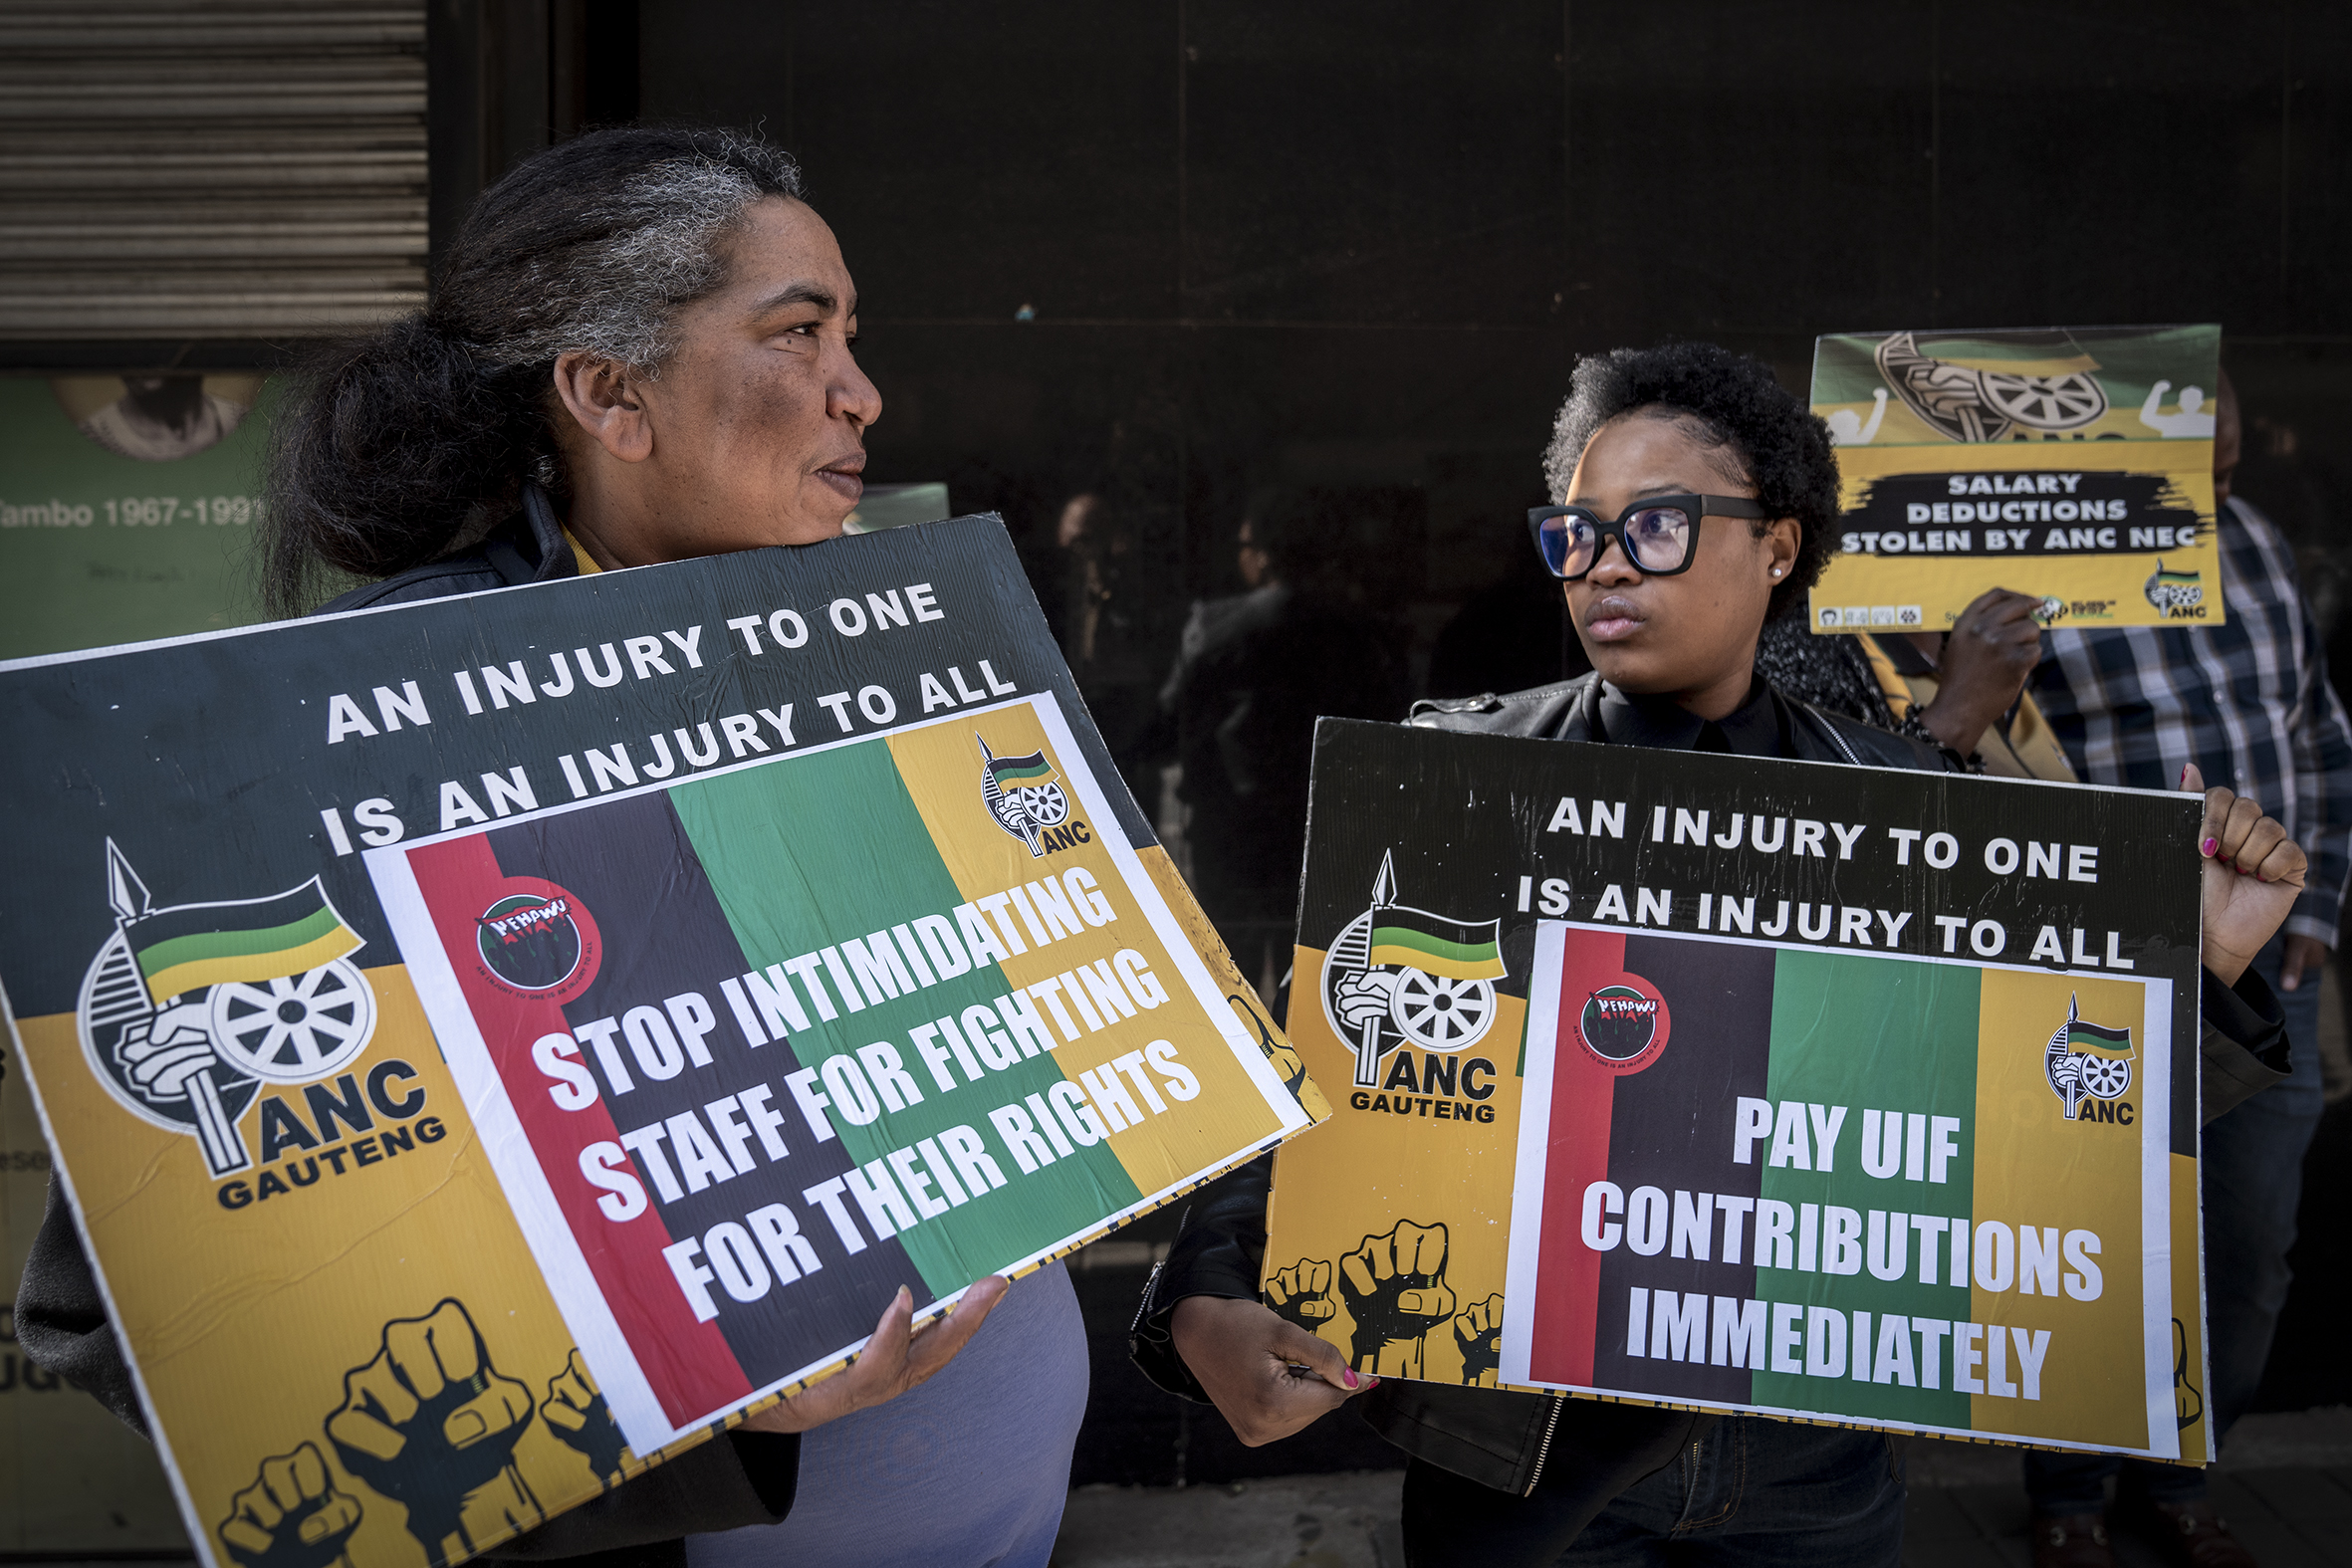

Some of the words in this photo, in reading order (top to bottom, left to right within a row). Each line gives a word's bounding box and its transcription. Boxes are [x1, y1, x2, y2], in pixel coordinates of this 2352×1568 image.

[1948, 473, 2082, 495] SALARY
[0, 497, 94, 527] ambo
[1907, 500, 2128, 525] DEDUCTIONS
[1841, 530, 1972, 554] STOLEN
[1985, 529, 2031, 551] BY
[2044, 528, 2117, 550] ANC
[2128, 526, 2196, 548] NEC
[2170, 606, 2207, 618] ANC
[327, 678, 431, 745] AN
[453, 625, 703, 715] INJURY
[728, 608, 810, 657] TO
[828, 582, 945, 637] ONE
[320, 796, 404, 855] IS
[438, 765, 538, 830] AN
[558, 703, 801, 798] INJURY
[818, 683, 897, 733] TO
[921, 659, 1016, 713] ALL
[1043, 820, 1090, 854] ANC
[1546, 796, 1626, 839] AN
[1651, 804, 1867, 860] INJURY
[1888, 827, 1960, 869] TO
[1984, 837, 2099, 883] ONE
[489, 899, 567, 937] NEHAWU
[1517, 875, 1571, 916] IS
[1593, 884, 1672, 926] AN
[1698, 892, 1913, 947] INJURY
[1934, 914, 2006, 958] TO
[2028, 925, 2136, 969] ALL
[476, 966, 487, 976] AN
[485, 976, 513, 996] INJURY
[531, 992, 717, 1112] STOP
[719, 866, 1116, 1049] INTIMIDATING
[1597, 999, 1656, 1012] NEHAWU
[1382, 1050, 1497, 1101] ANC
[1575, 1034, 1589, 1054] INJURY
[1627, 1056, 1647, 1067] INJURY
[579, 1082, 790, 1222] STAFF
[784, 1039, 924, 1143] FOR
[907, 948, 1170, 1093] FIGHTING
[1350, 1091, 1496, 1123] GAUTENG
[260, 1058, 427, 1165] ANC
[2078, 1099, 2134, 1126] ANC
[216, 1115, 448, 1211] GAUTENG
[1733, 1096, 1848, 1173] PAY
[1861, 1108, 1961, 1184] UIF
[662, 1202, 823, 1323] FOR
[803, 1124, 1008, 1255] THEIR
[987, 1038, 1201, 1175] RIGHTS
[1580, 1180, 2104, 1302] CONTRIBUTIONS
[1626, 1286, 2051, 1401] IMMEDIATELY
